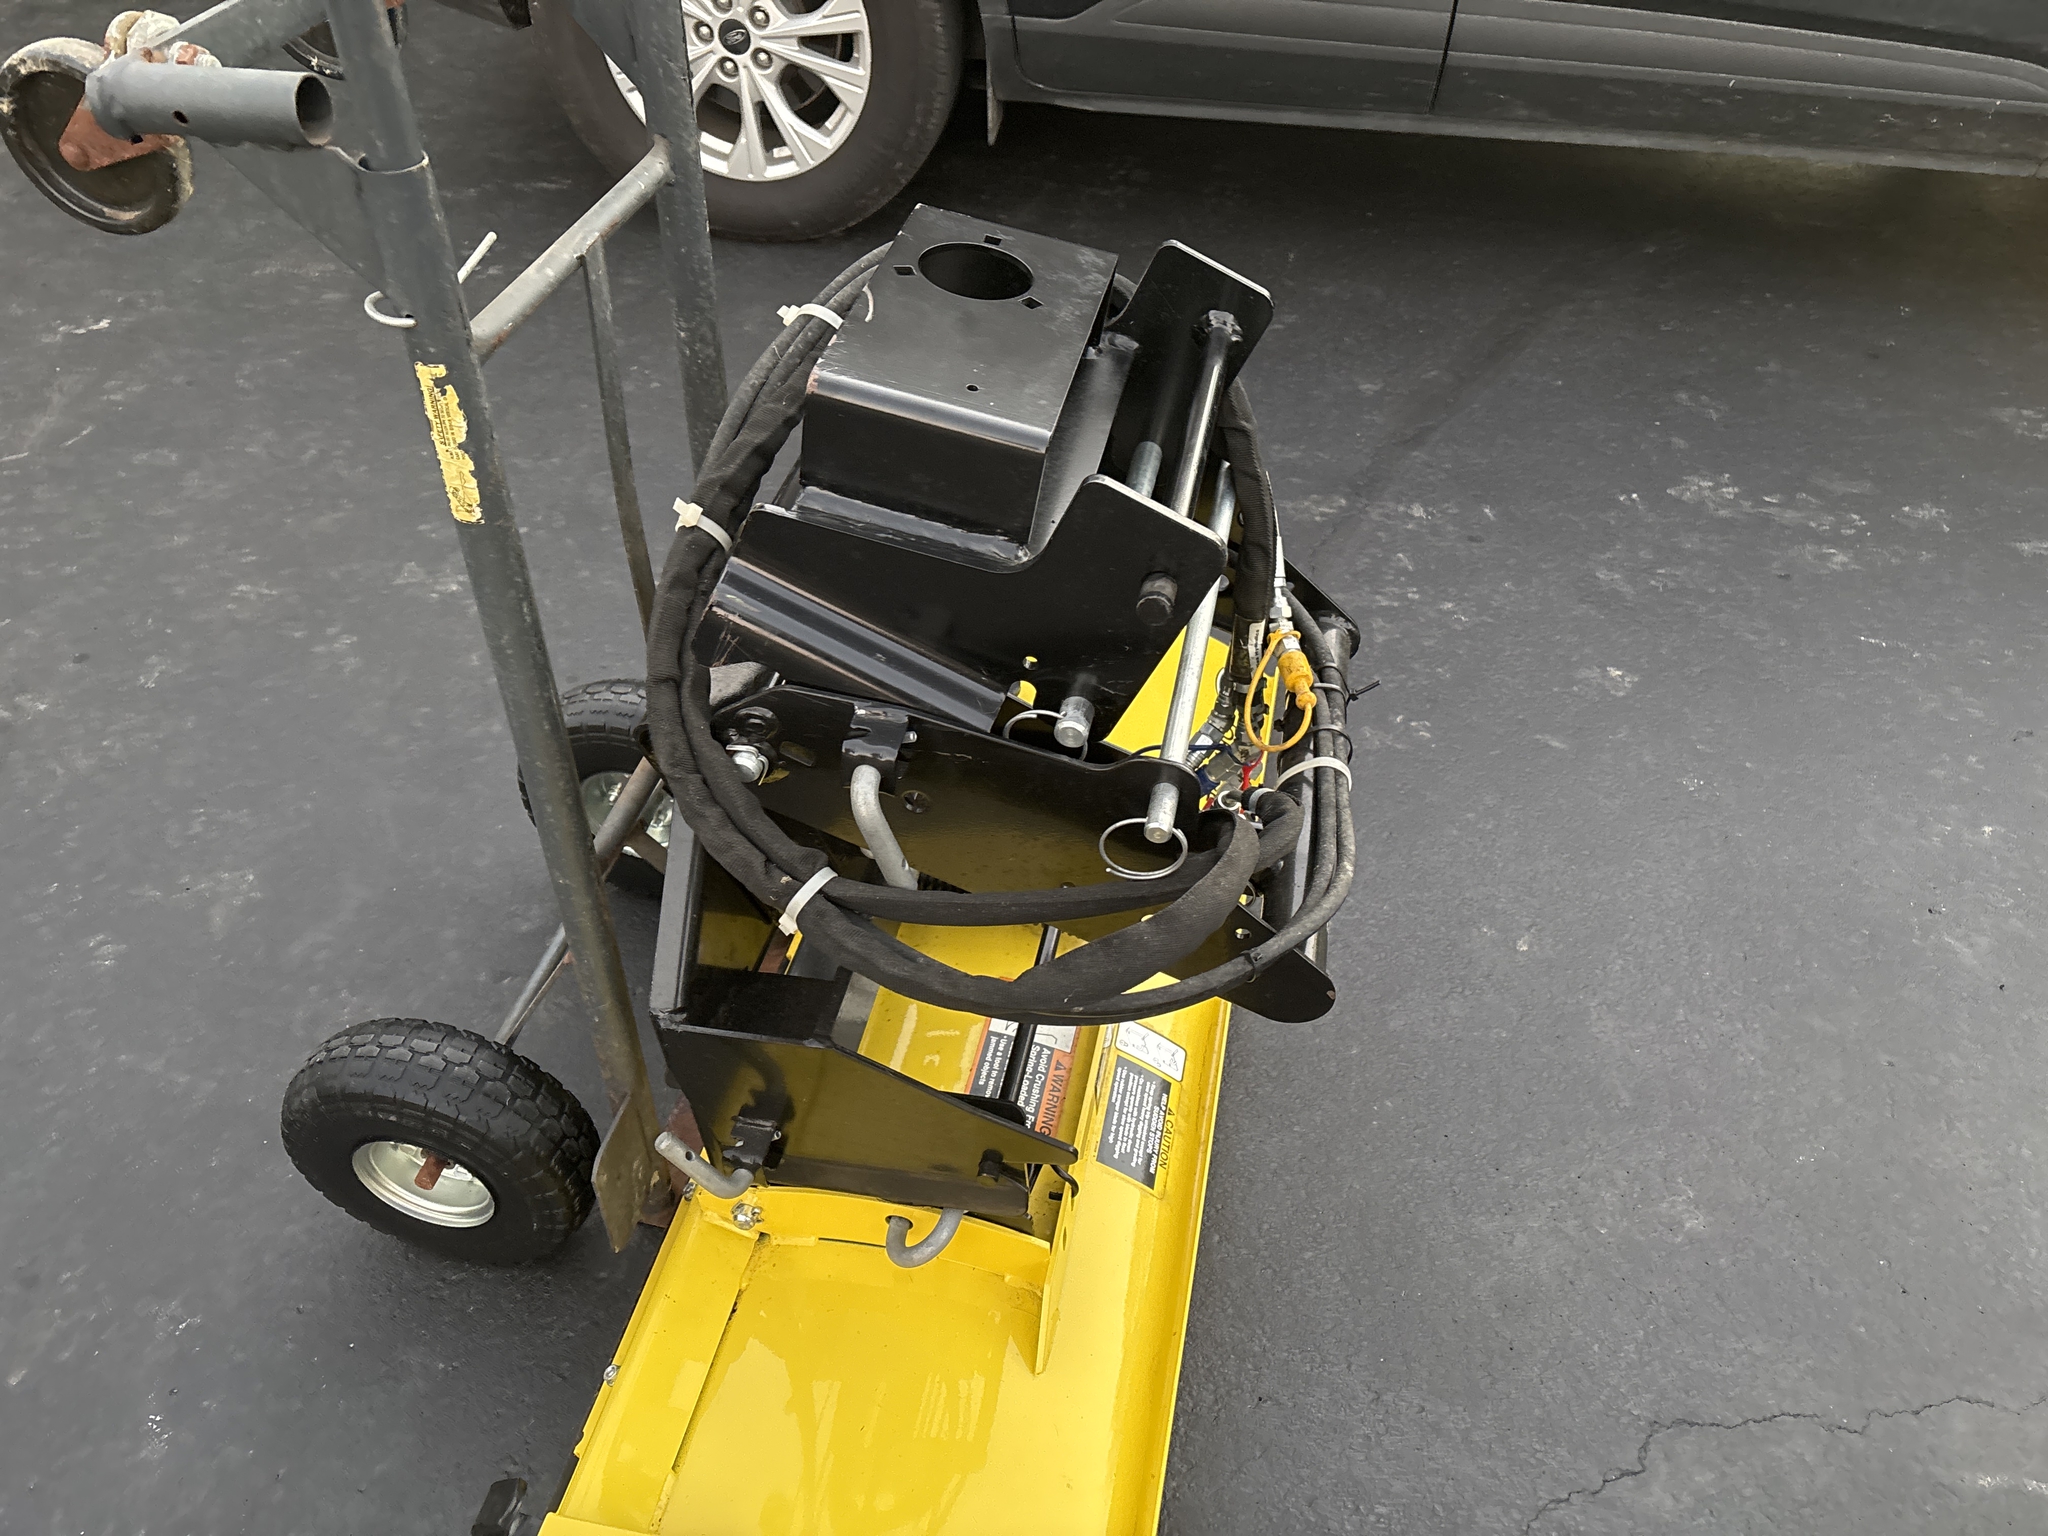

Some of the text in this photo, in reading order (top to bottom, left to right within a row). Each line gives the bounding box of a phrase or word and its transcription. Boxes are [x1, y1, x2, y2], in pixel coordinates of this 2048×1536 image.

[978, 1035, 999, 1085] jammed objects
[992, 1056, 1003, 1070] tool
[997, 1038, 1008, 1051] Use
[1037, 1047, 1051, 1073] Avoid
[984, 1077, 996, 1098] remov
[990, 1070, 999, 1078] to
[1025, 1073, 1045, 1113] Crushing
[1040, 1073, 1064, 1137] WARNING
[1146, 1105, 1160, 1154] SUDDEN STOPS
[1149, 1092, 1168, 1174] HELP AVOID INJURY FROM
[1159, 1119, 1174, 1170] CAUTION
